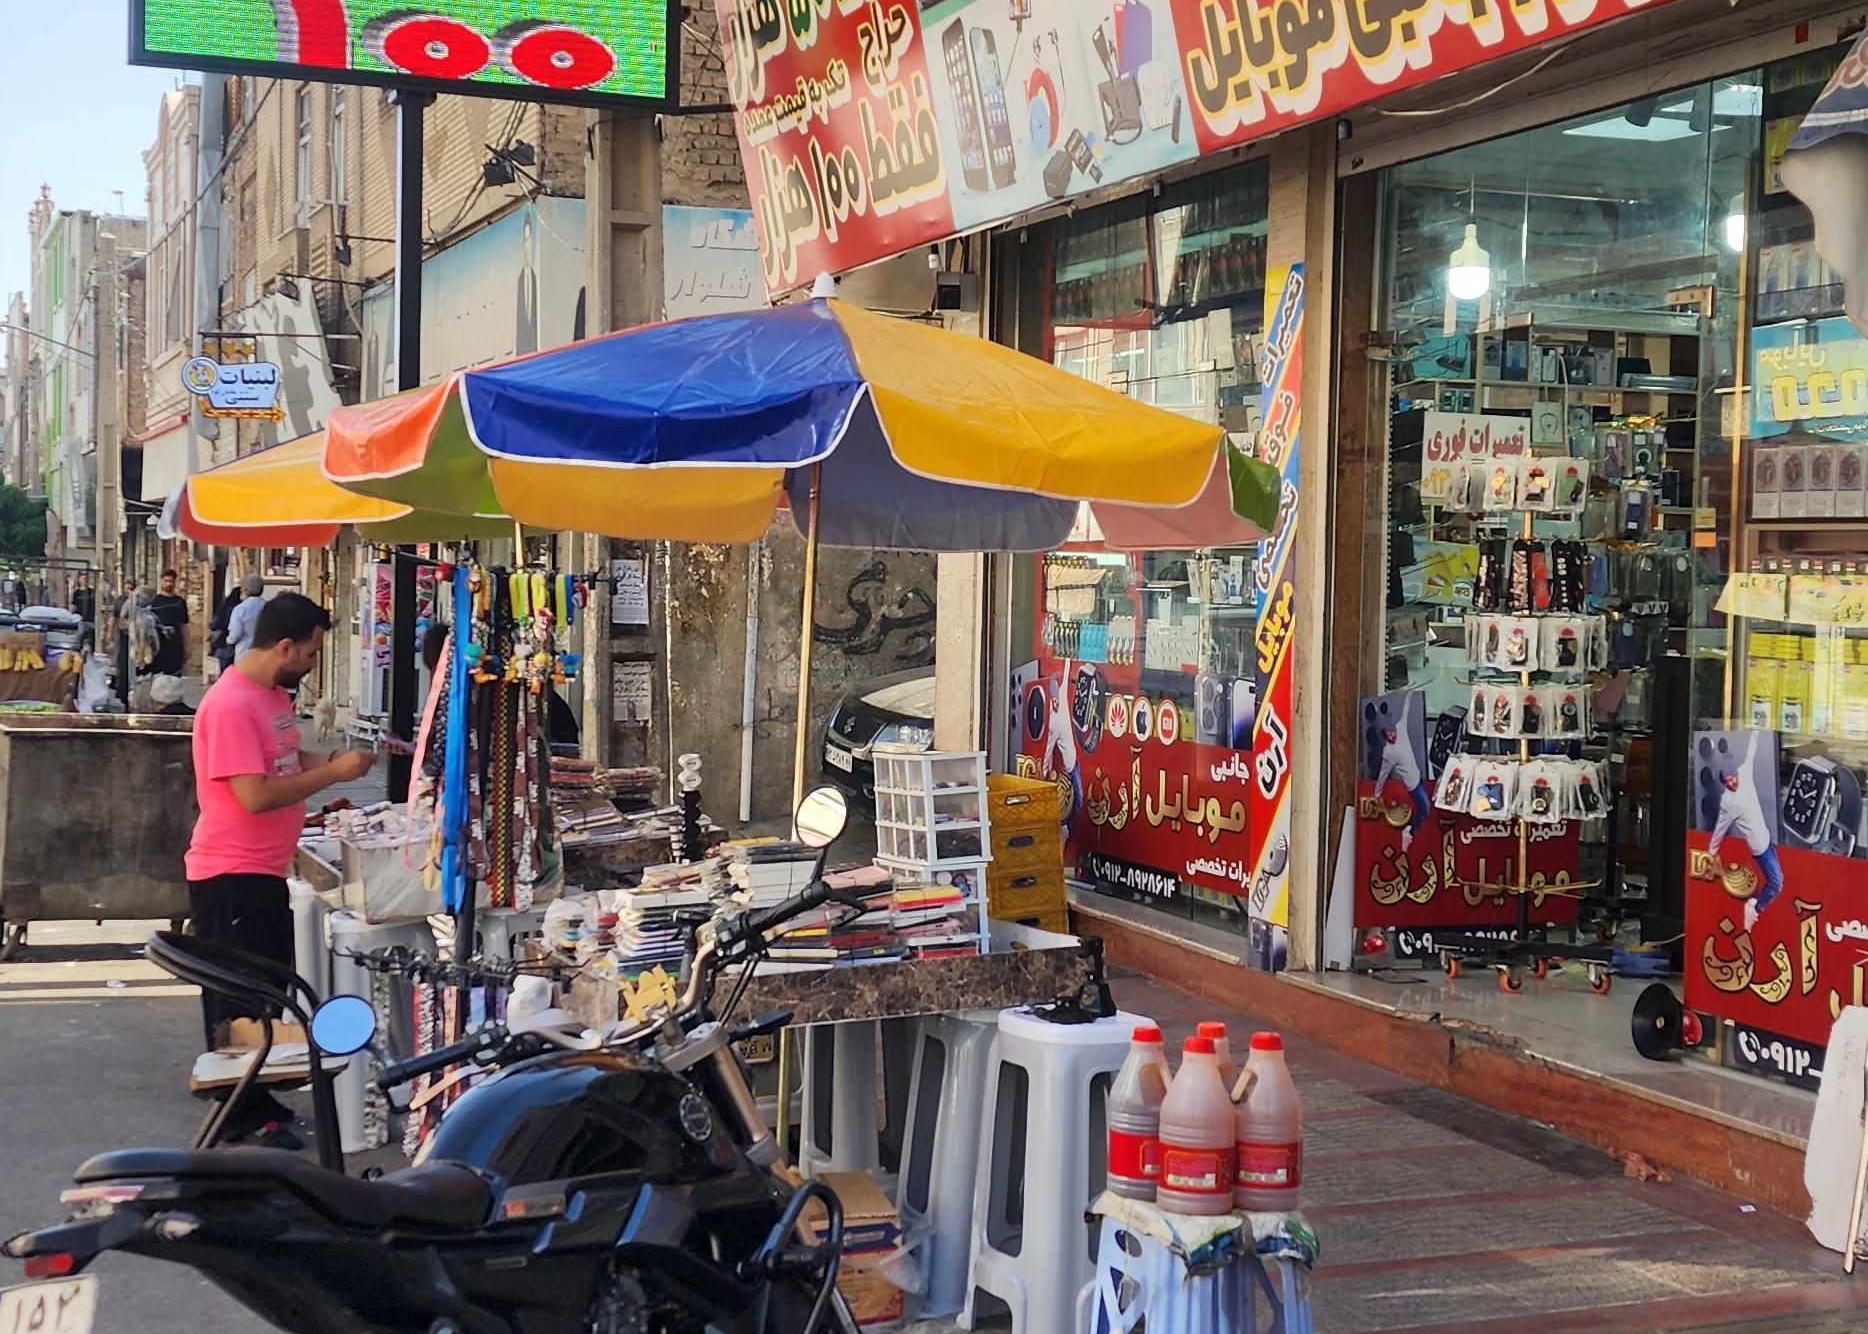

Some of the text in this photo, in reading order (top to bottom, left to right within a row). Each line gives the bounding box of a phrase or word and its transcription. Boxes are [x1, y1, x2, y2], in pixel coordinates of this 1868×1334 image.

[857, 0, 913, 94] حراج
[774, 75, 812, 134] قیمت
[808, 77, 828, 123] به
[759, 70, 949, 287] فقط ۱۰۰ هزار
[1262, 271, 1304, 387] تعمیرات
[219, 368, 276, 390] لبنیات
[1427, 418, 1467, 462] فوری
[1258, 581, 1293, 673] موبایل
[1087, 746, 1247, 844] موبایل آرن
[1211, 753, 1250, 786] جانبی
[1256, 702, 1287, 801] آرن
[1185, 857, 1227, 877] تخصصی
[1370, 818, 1456, 905] آرن
[1460, 820, 1512, 845] تخصصی
[1703, 898, 1823, 1005] آرن
